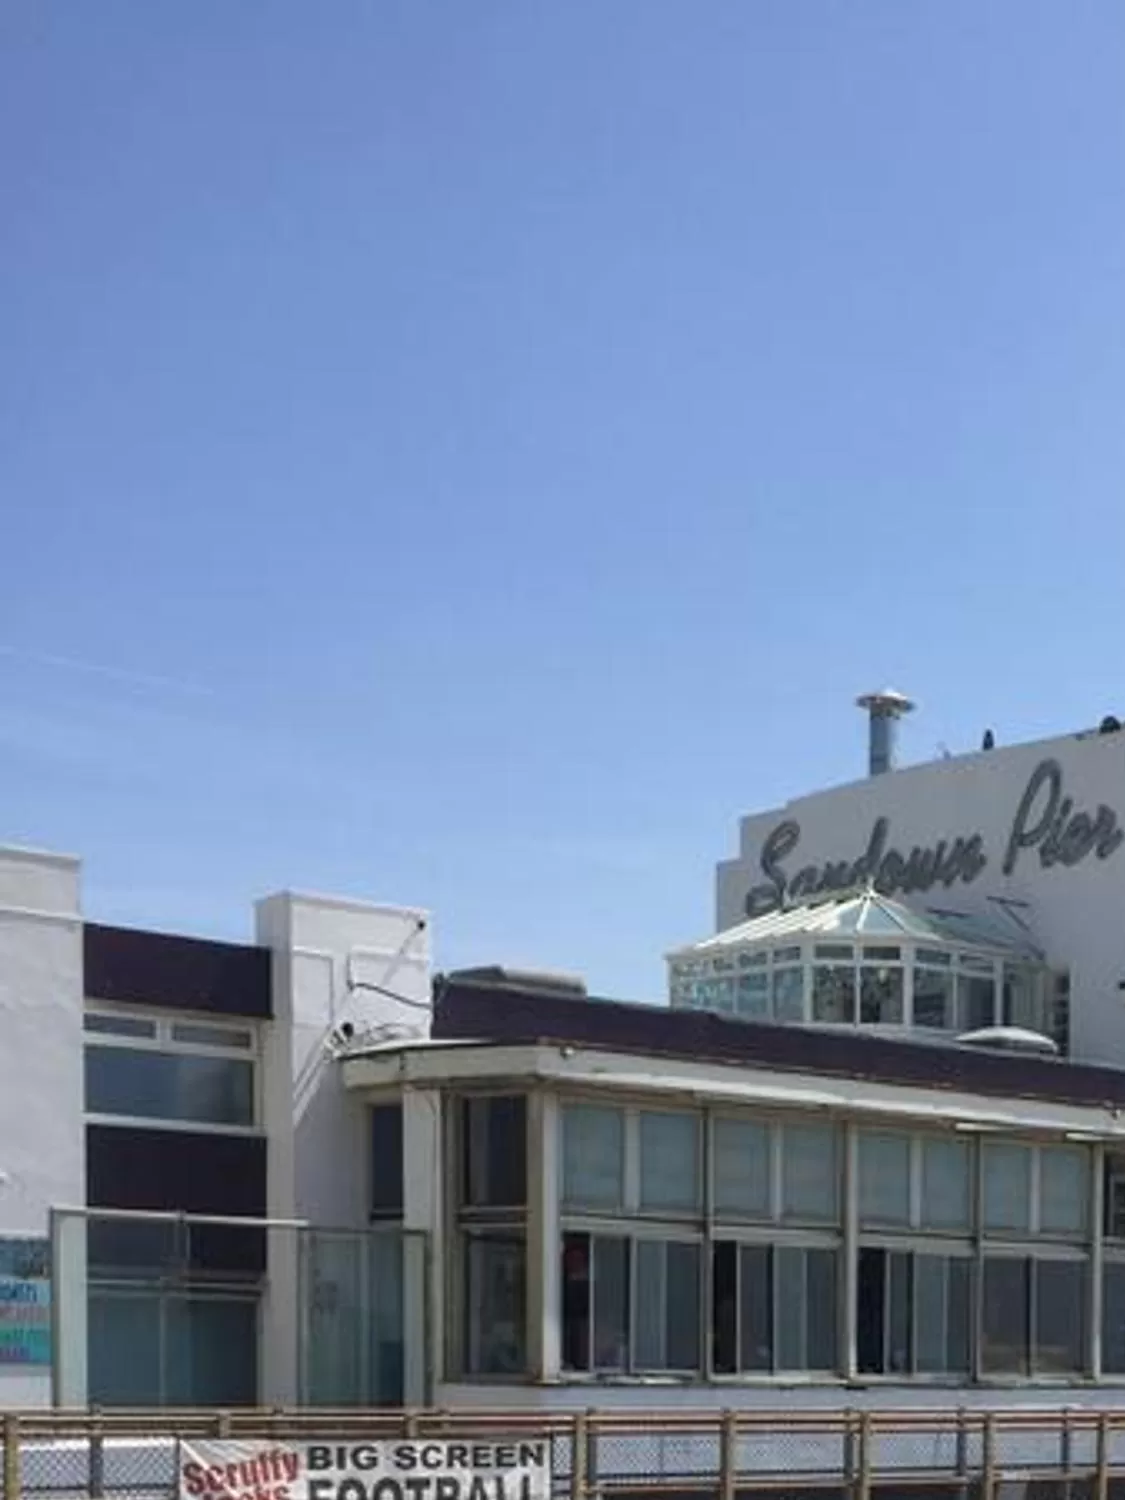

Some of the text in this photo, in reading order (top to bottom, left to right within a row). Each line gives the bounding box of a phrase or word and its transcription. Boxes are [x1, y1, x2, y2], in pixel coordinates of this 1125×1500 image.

[746, 758, 1125, 916] Sandown Pier
[182, 1449, 298, 1496] Scruffy
[308, 1443, 544, 1470] BIG SCREEN
